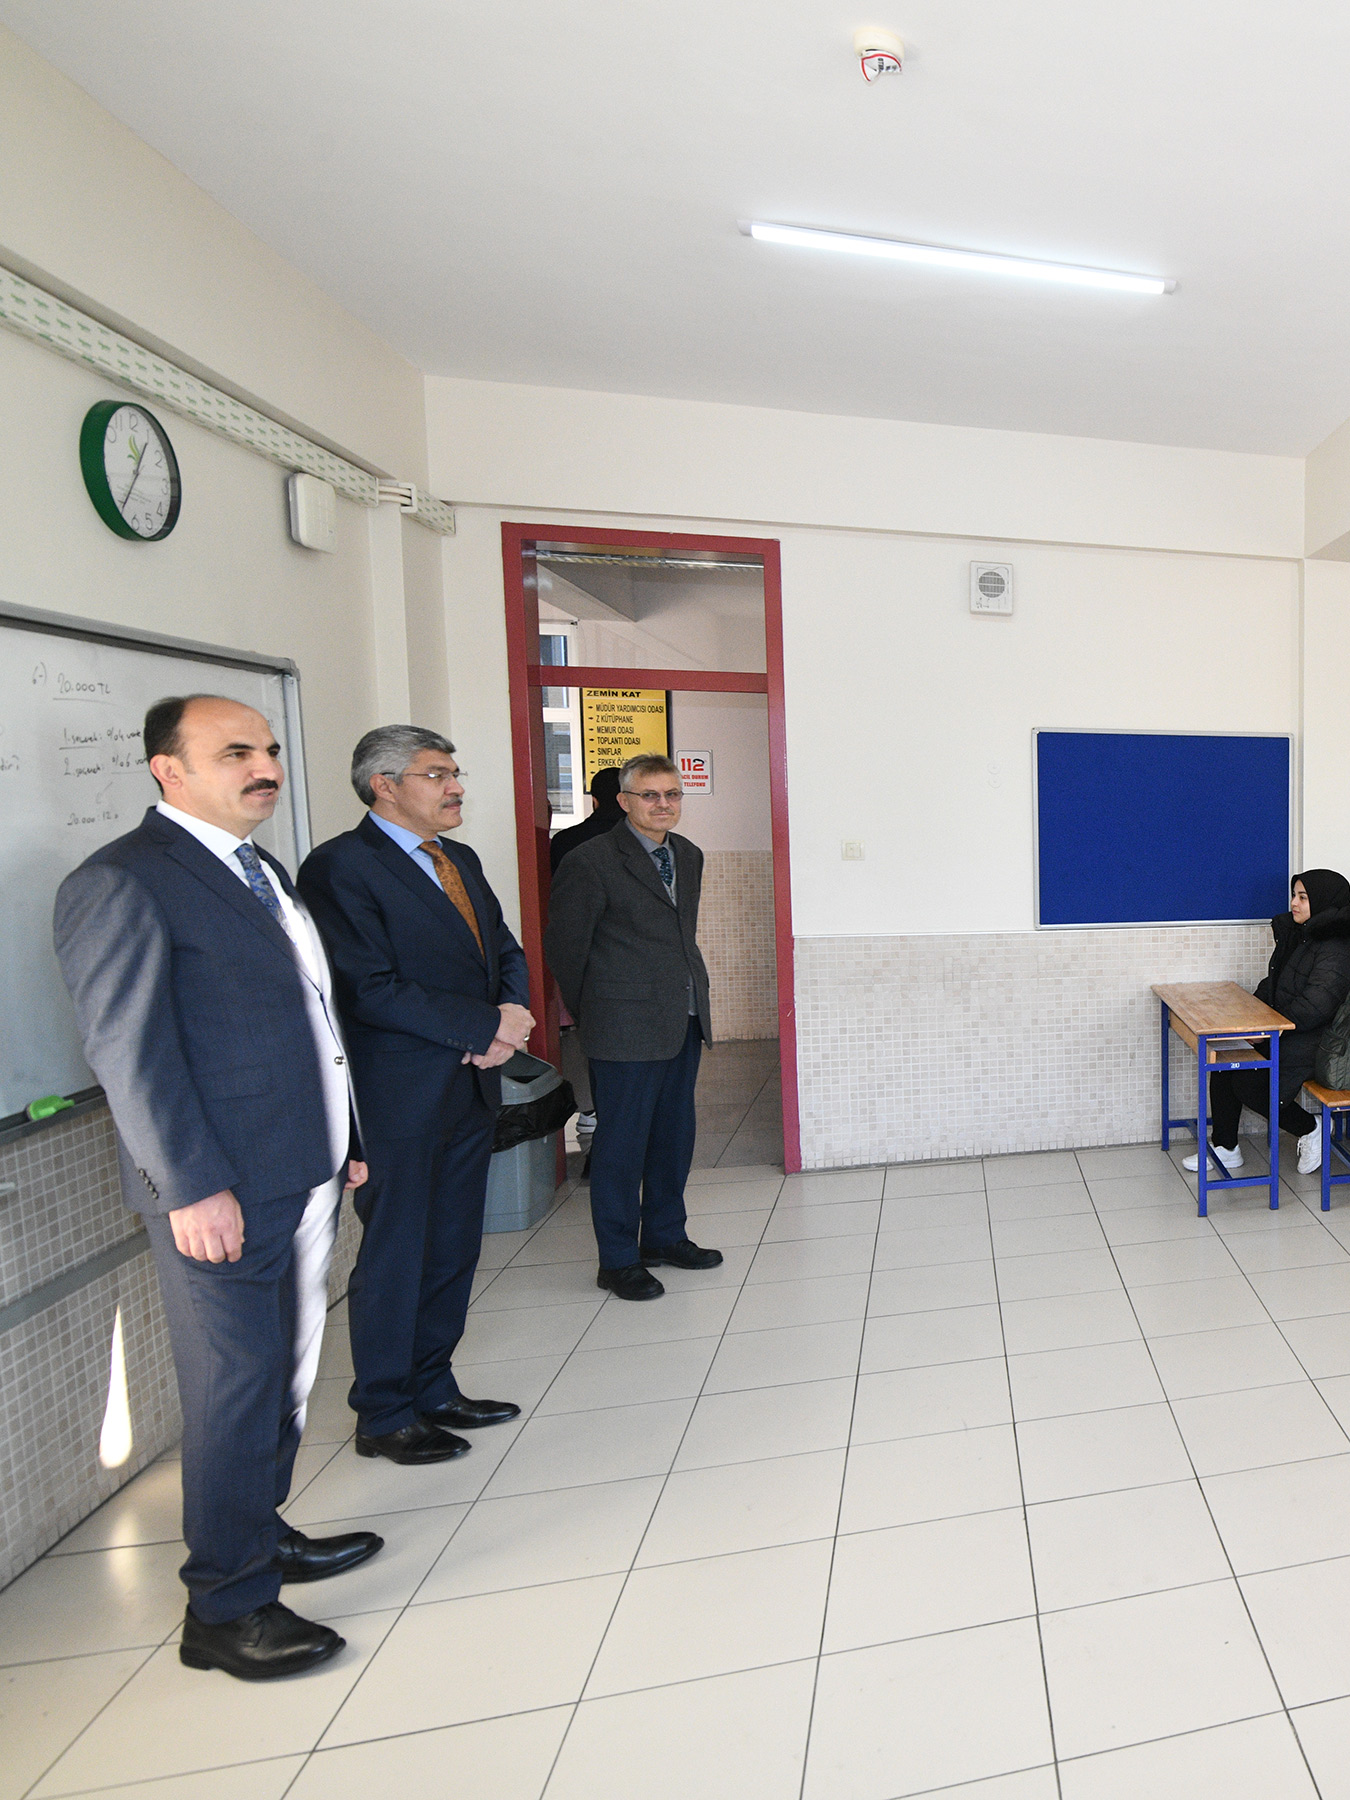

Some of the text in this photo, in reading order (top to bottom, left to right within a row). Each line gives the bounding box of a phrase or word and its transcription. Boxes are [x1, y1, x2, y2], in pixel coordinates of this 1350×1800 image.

[128, 411, 139, 432] 12
[154, 449, 163, 468] 2
[161, 478, 169, 496] 3
[156, 501, 164, 517] 4
[131, 513, 140, 532] 6
[145, 513, 153, 531] 5
[596, 702, 664, 714] MÜDÜR YARDIMCISI ODASI
[596, 713, 634, 723] Z KÜTÜPHANE
[597, 726, 634, 735] MEMUR ODASI
[597, 737, 641, 746] TOPLANTI ODASI
[597, 748, 622, 756] SINIFLAR
[597, 759, 617, 767] ERKEK
[681, 758, 705, 771] 112
